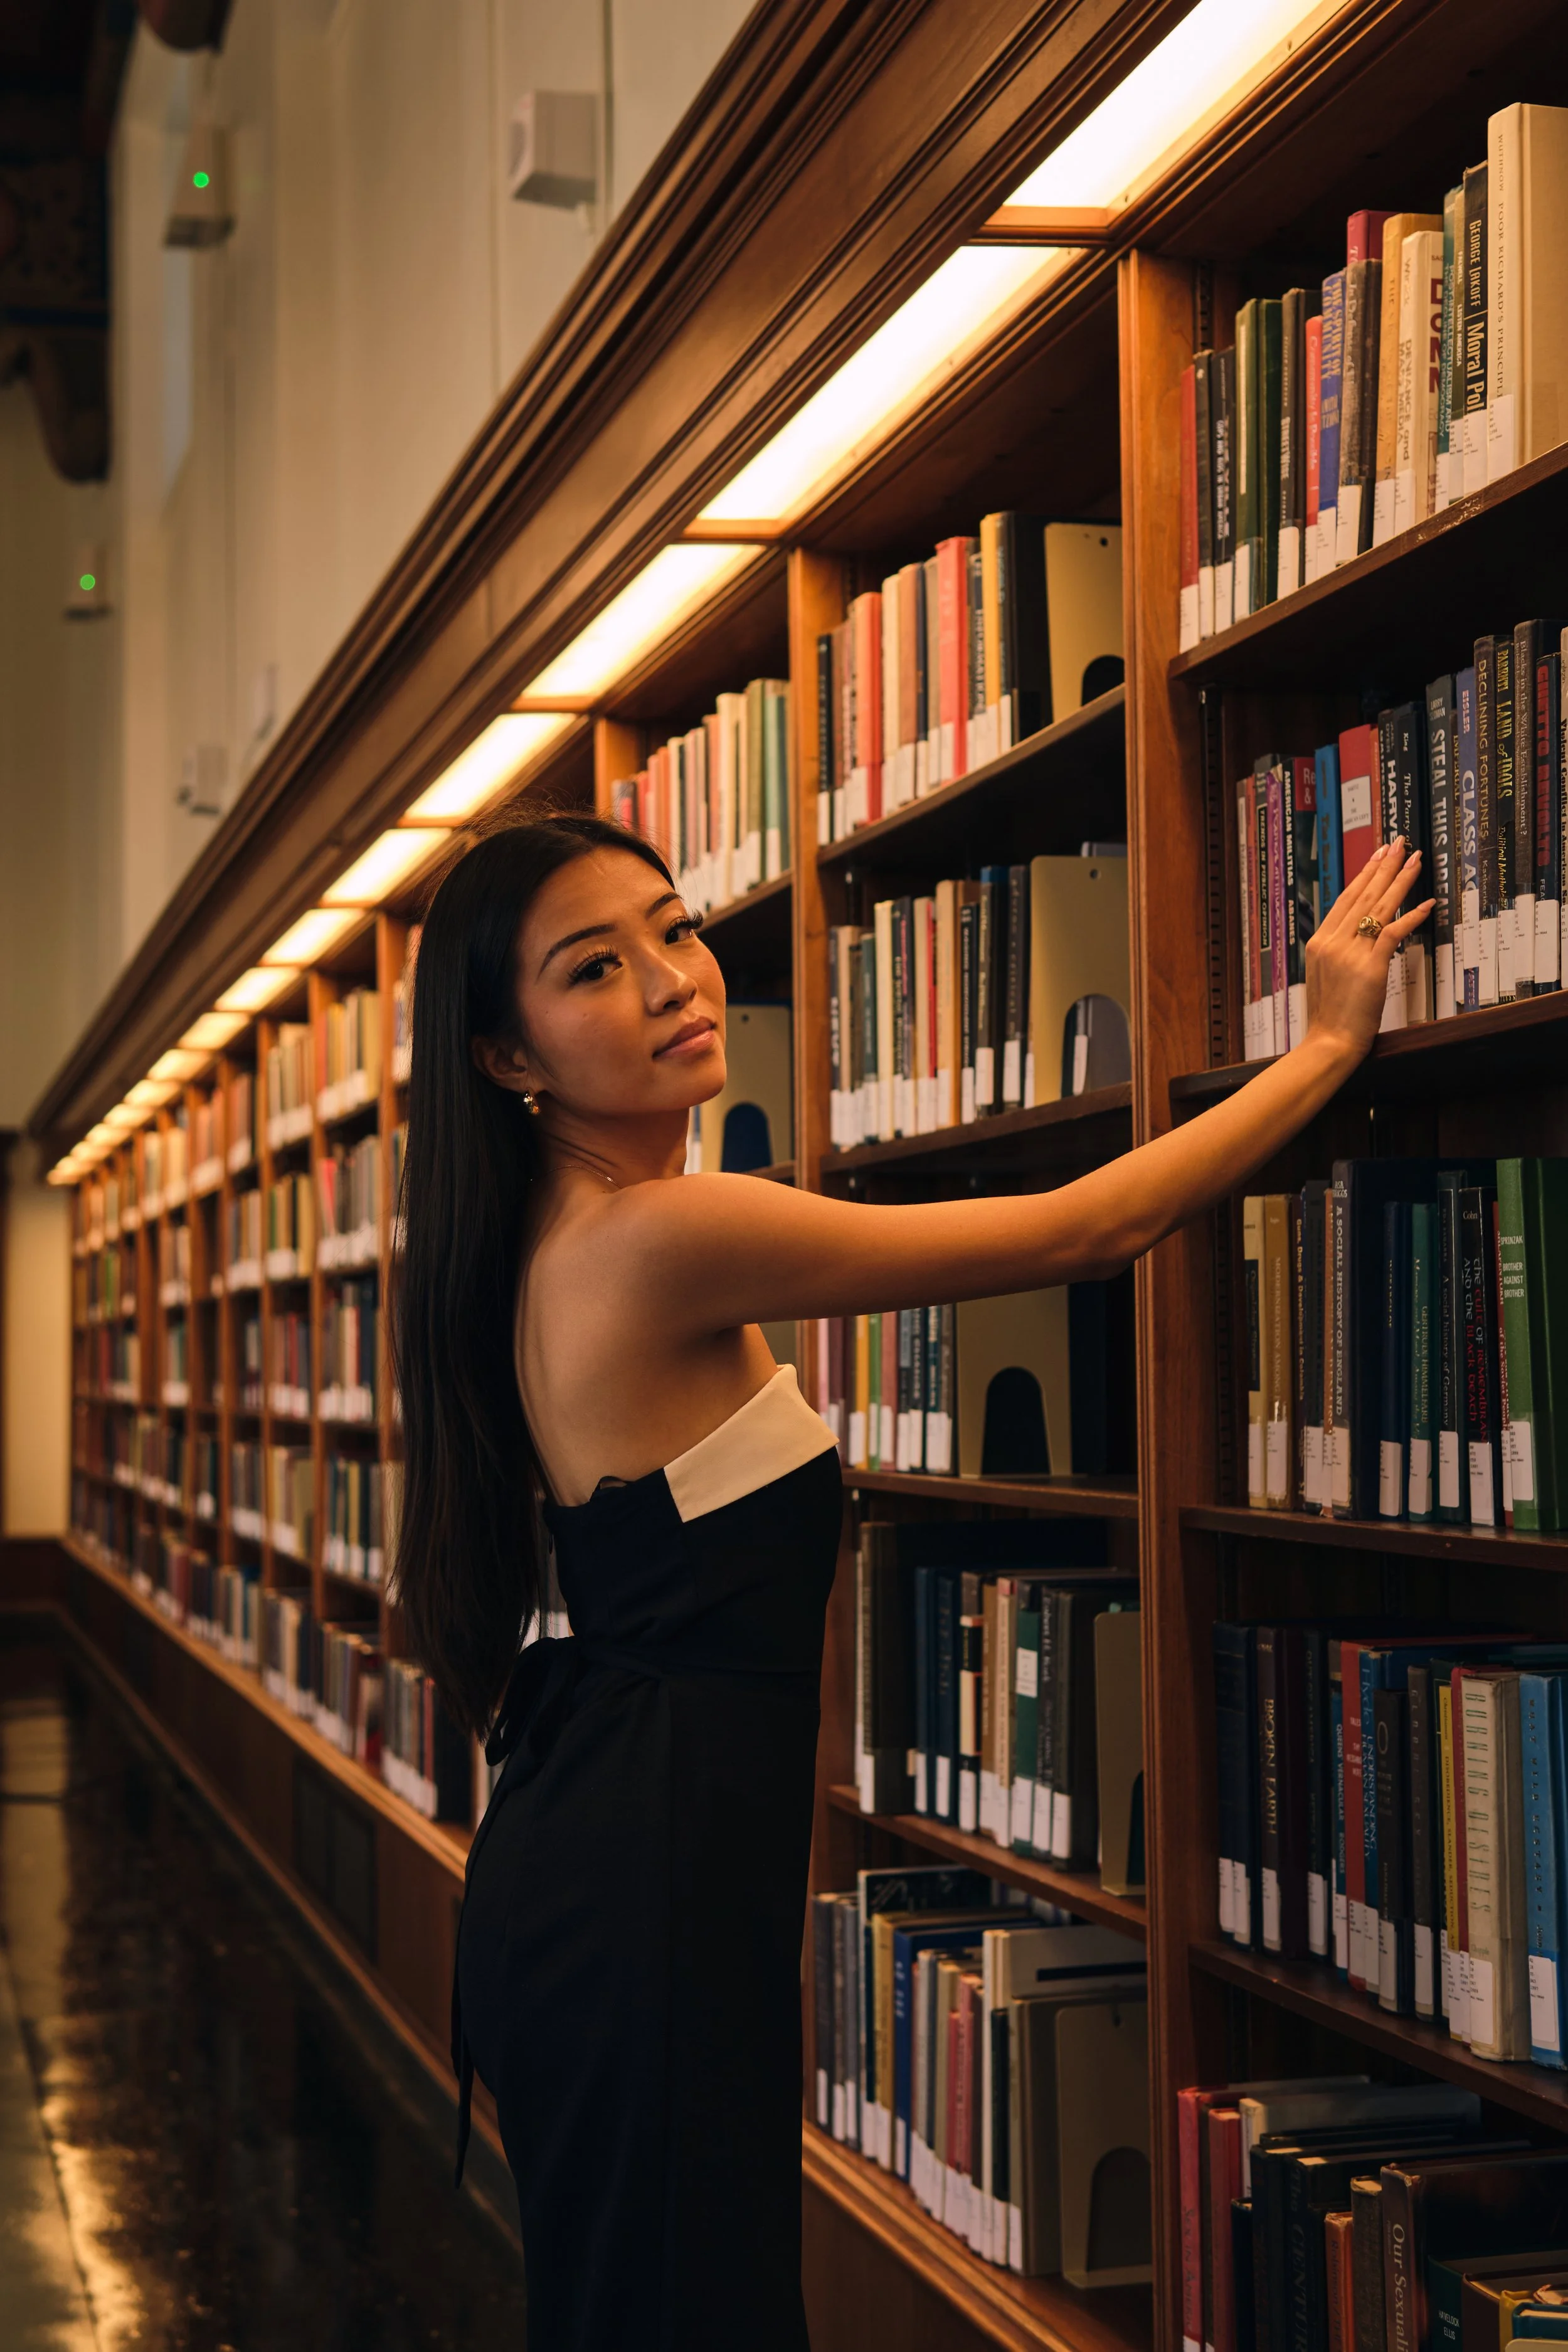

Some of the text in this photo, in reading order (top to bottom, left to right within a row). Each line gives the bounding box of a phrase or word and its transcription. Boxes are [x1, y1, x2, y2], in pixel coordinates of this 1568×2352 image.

[1469, 220, 1481, 307] GEORGE LAKOFF
[1322, 285, 1333, 379] COMMUNITY
[1331, 308, 1343, 358] SPIRIT
[1467, 320, 1485, 379] Moral
[1431, 697, 1443, 710] LARRY
[1520, 681, 1527, 689] in
[1462, 690, 1470, 734] EISLER
[1497, 649, 1513, 800] PARENTI LAND of IDOLS
[1479, 659, 1489, 839] DECLINING FORTUNES
[1403, 798, 1411, 832] Party
[1462, 770, 1476, 856] CLASS
[1518, 752, 1527, 835] Establishment?
[1432, 728, 1449, 927] STEAL THIS DREAM
[1498, 826, 1507, 862] Political
[1287, 899, 1295, 945] ABANES
[1335, 1180, 1344, 1189] ASA
[1337, 1206, 1343, 1216] A
[1463, 1210, 1478, 1220] Cohn
[1501, 1235, 1523, 1245] SPRINZAK
[1443, 1275, 1449, 1285] A
[1503, 1262, 1523, 1272] BROTHER
[1503, 1275, 1524, 1285] AGAINST
[1504, 1289, 1525, 1299] BROTHER
[1337, 1331, 1343, 1347] OF
[1444, 1361, 1450, 1374] of
[1362, 1668, 1372, 1725] Hyde
[1528, 1698, 1537, 1744] WHAT
[1264, 1698, 1278, 1835] BROKEN EARTH
[1530, 1757, 1539, 1801] WILD
[1367, 1735, 1377, 1850] UNDERSTANDING
[1465, 1693, 1491, 1913] BURNING DESIRES
[1532, 1814, 1544, 1894] ECSTASY
[1290, 2169, 1301, 2212] The
[1392, 2223, 1405, 2269] Our
[1330, 2240, 1340, 2305] Robinson
[1439, 2310, 1460, 2328] HAVELOCK
[1444, 2326, 1456, 2340] ELLIS
